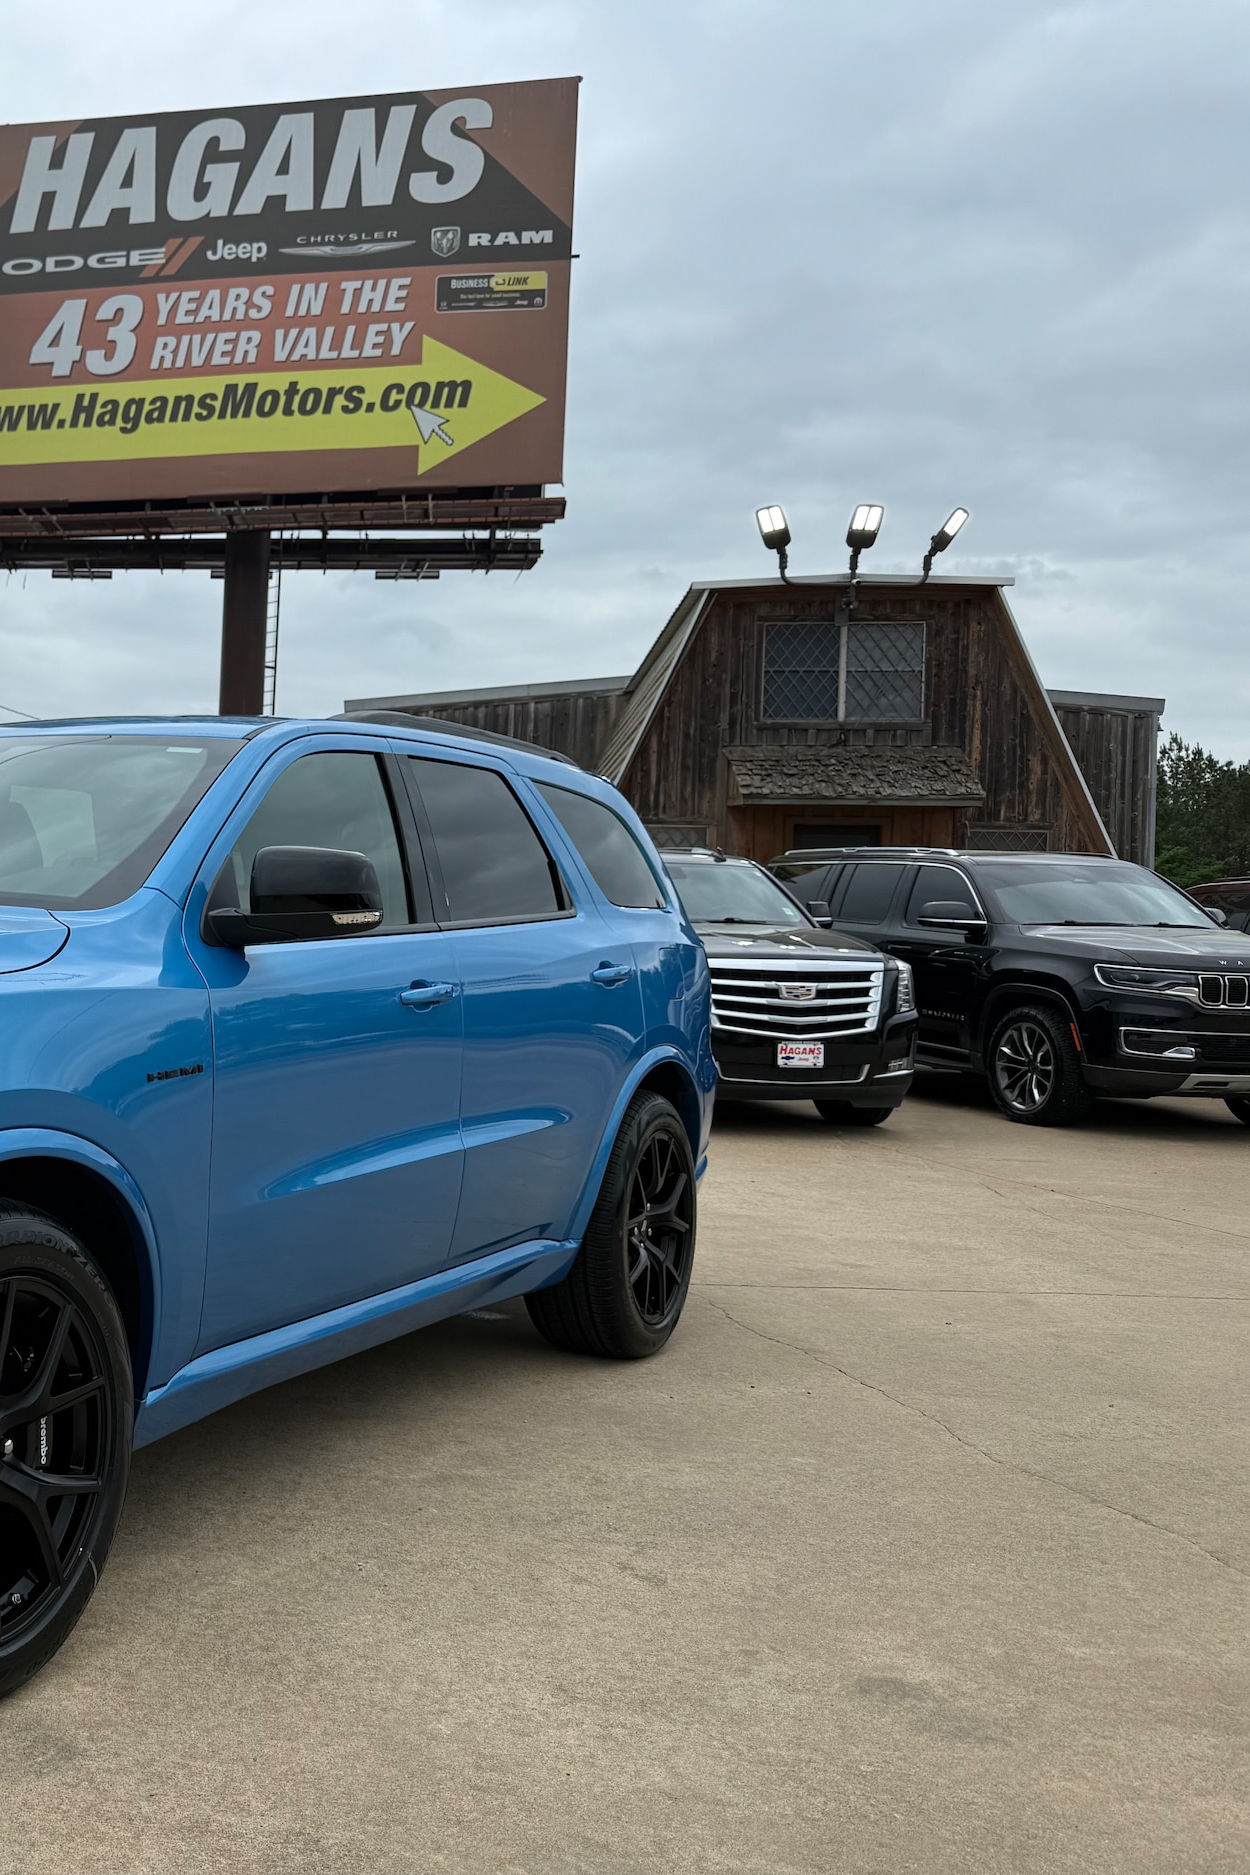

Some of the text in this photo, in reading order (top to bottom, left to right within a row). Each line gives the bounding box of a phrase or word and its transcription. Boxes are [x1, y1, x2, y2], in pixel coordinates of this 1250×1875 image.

[9, 98, 494, 235] HAGANS
[206, 238, 268, 262] Jeep
[296, 230, 399, 244] CHRYSLER
[468, 230, 553, 246] RAM
[451, 276, 529, 289] BUSINESS LINK
[156, 277, 412, 326] YEARS IN THE
[29, 294, 144, 378] 43
[150, 321, 415, 370] RIVER VALLEY
[146, 1063, 204, 1083] HEMI
[40, 1415, 48, 1465] brembo
